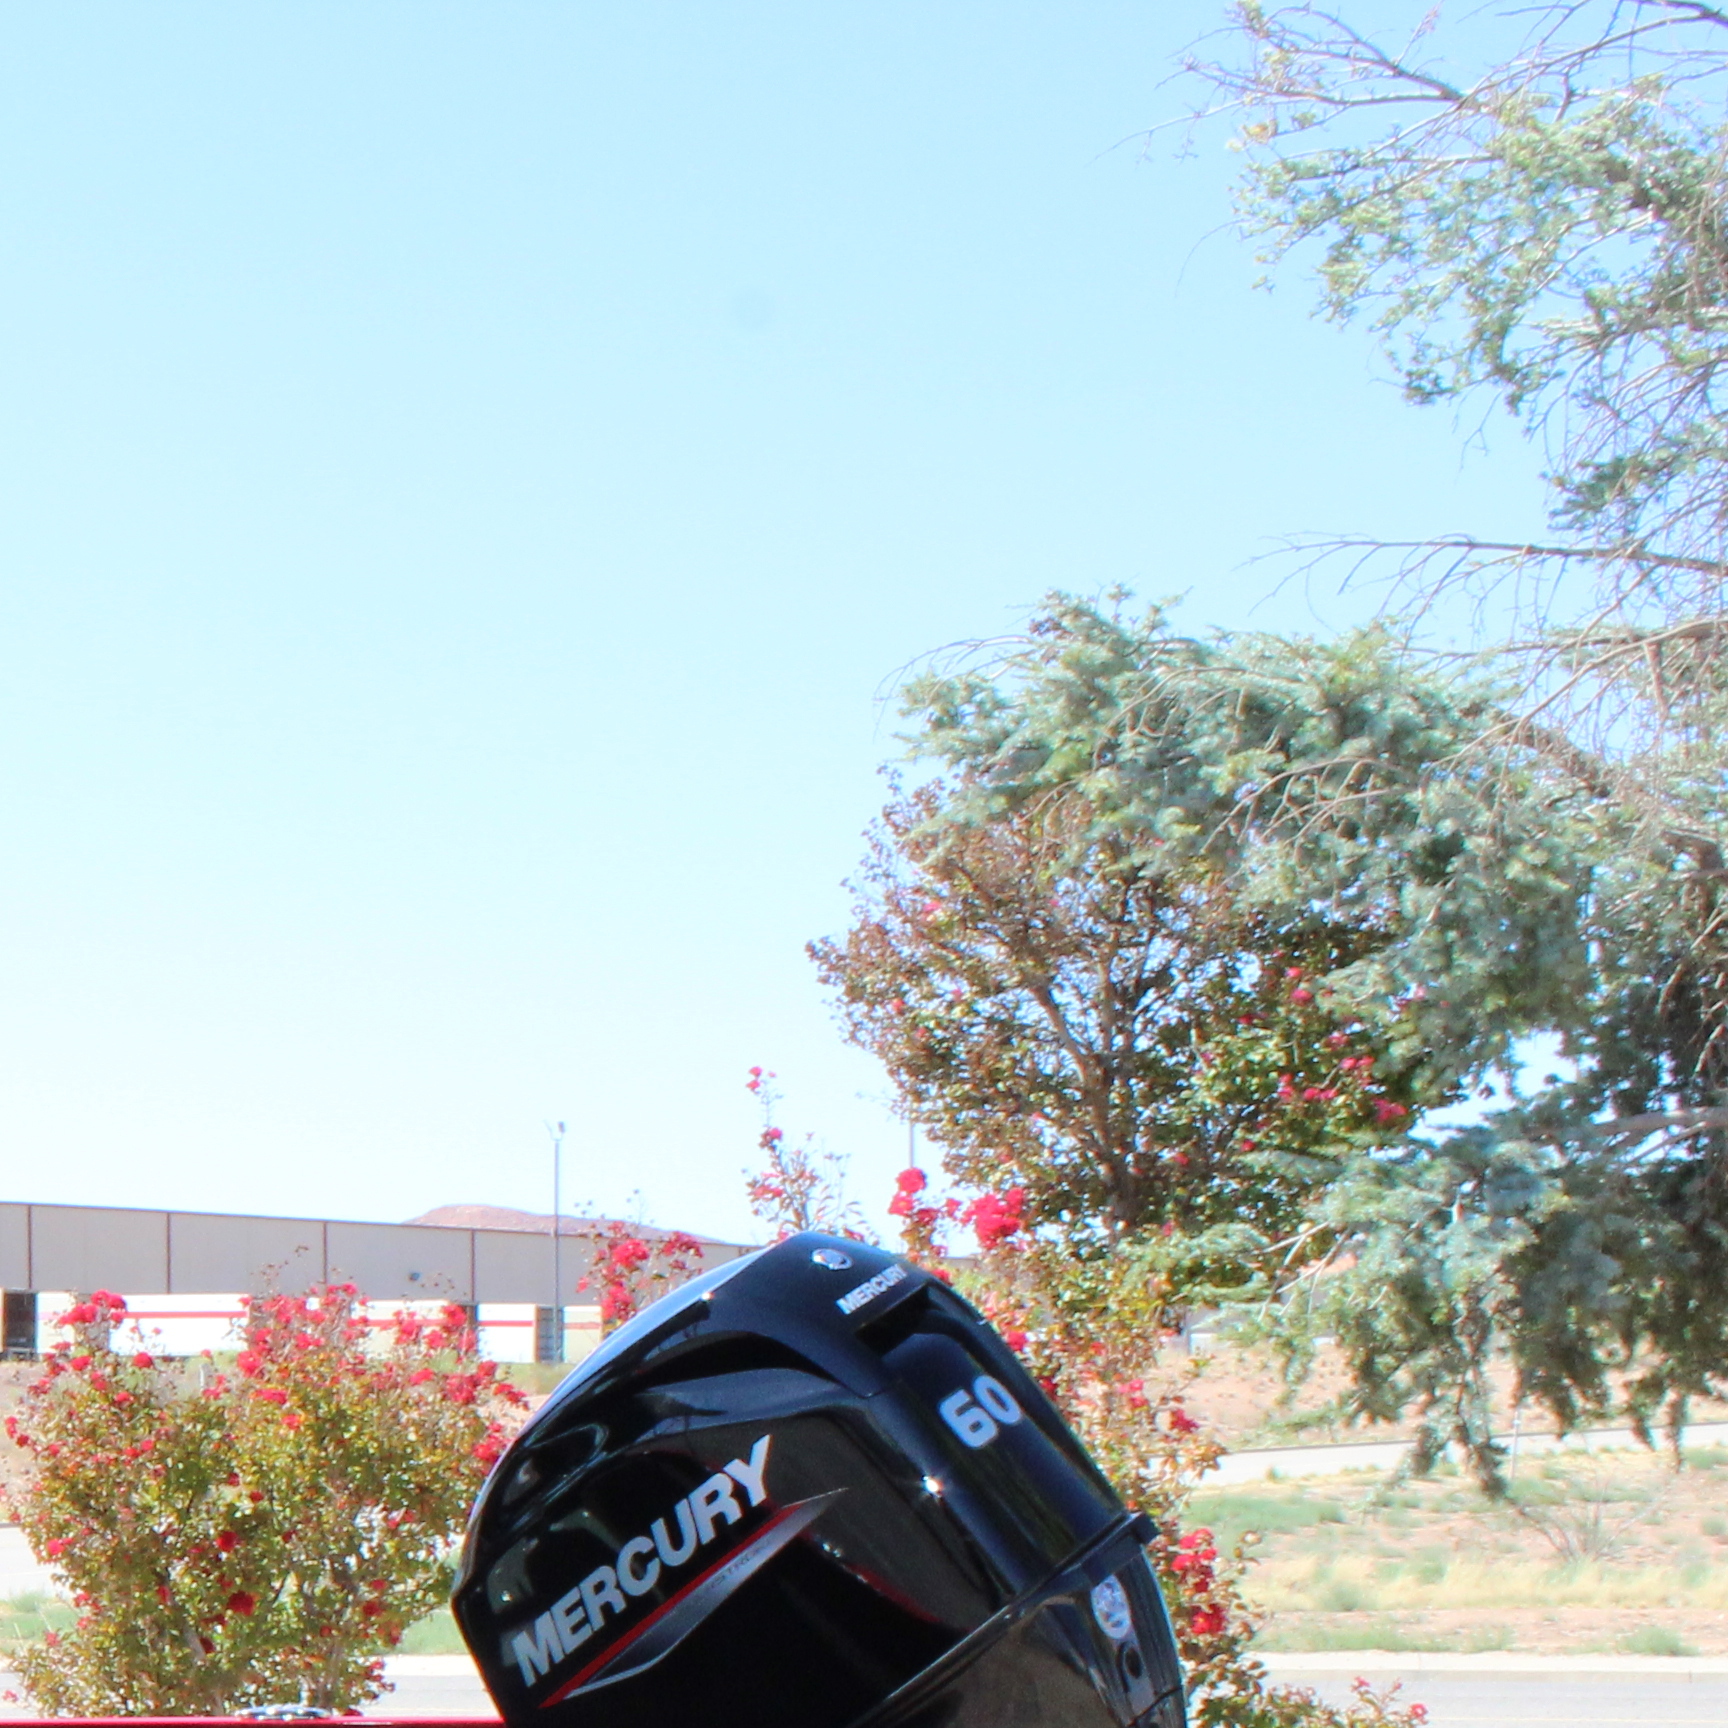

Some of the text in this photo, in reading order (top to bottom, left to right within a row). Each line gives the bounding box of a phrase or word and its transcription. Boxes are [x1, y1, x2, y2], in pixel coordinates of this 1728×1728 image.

[837, 1264, 908, 1315] MERCURY
[939, 1374, 1023, 1449] 60
[510, 1434, 774, 1687] MERCURY
